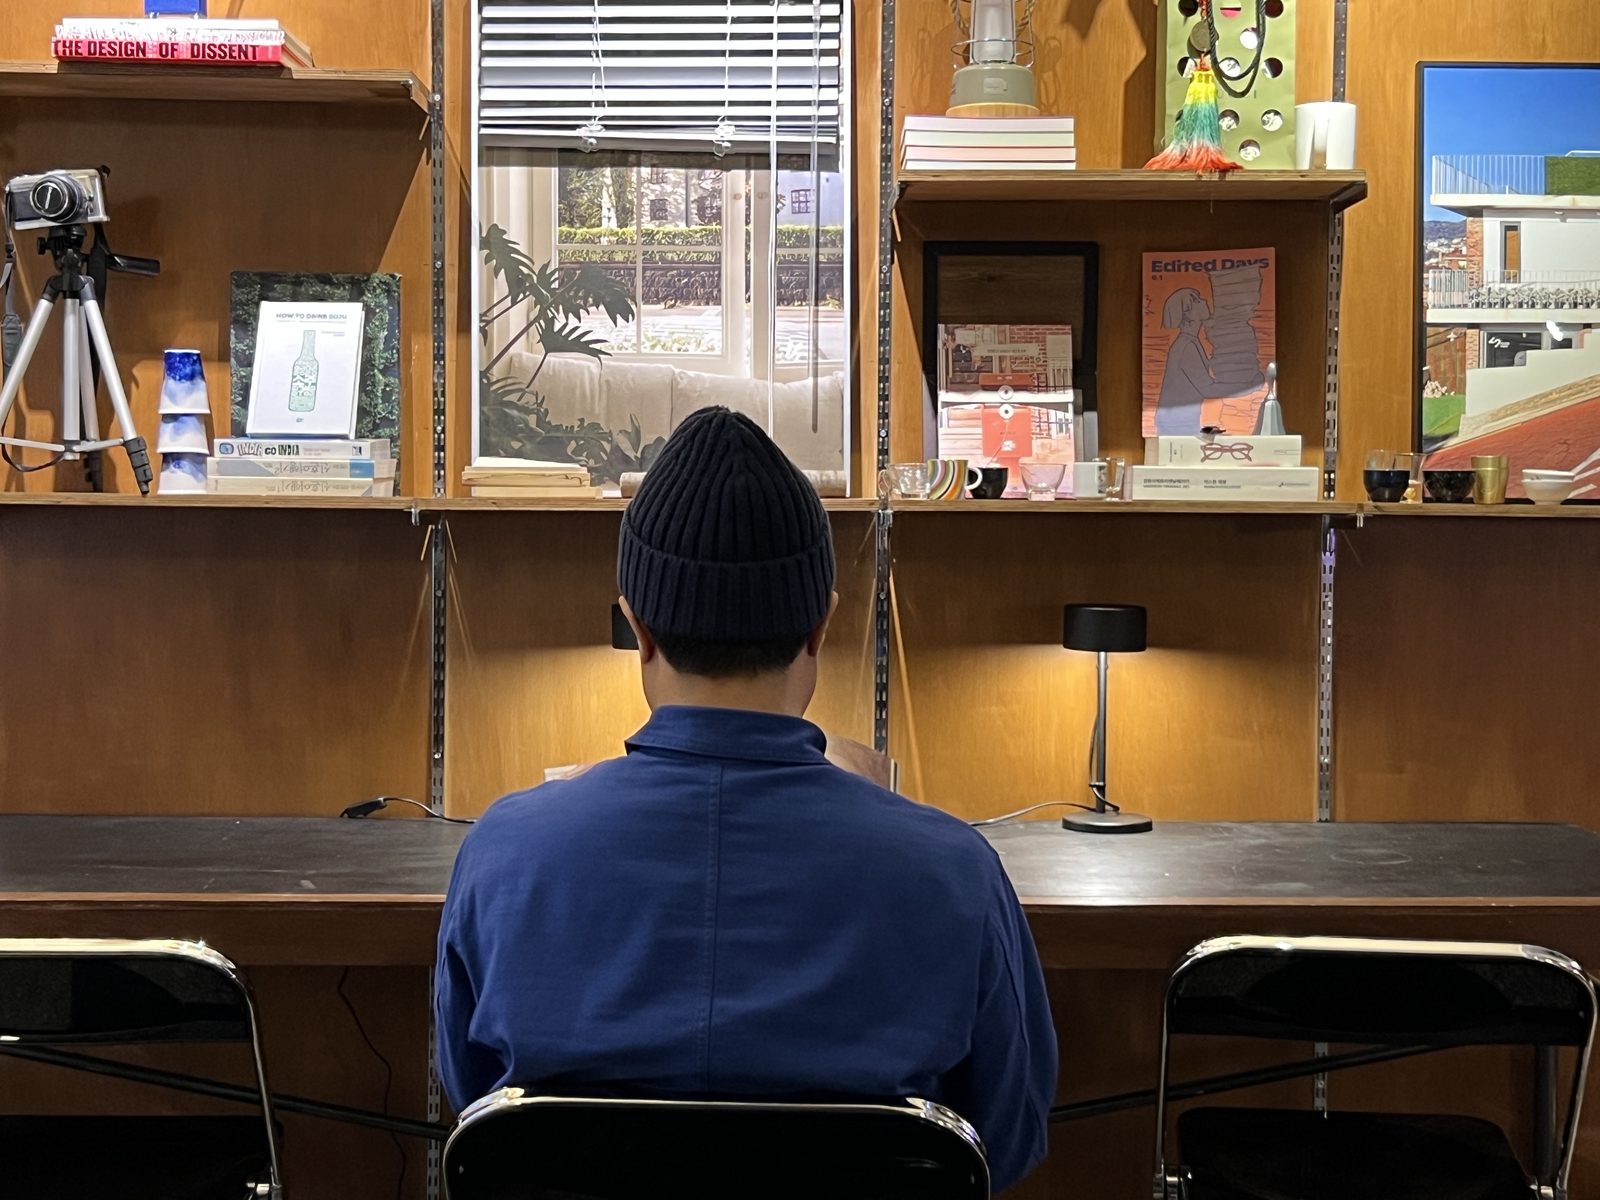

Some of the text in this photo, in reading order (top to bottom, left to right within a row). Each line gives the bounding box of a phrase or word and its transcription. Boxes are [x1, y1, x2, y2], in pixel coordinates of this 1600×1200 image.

[53, 39, 260, 60] THE DESIGN OF DISSENT
[1151, 259, 1217, 273] Edited
